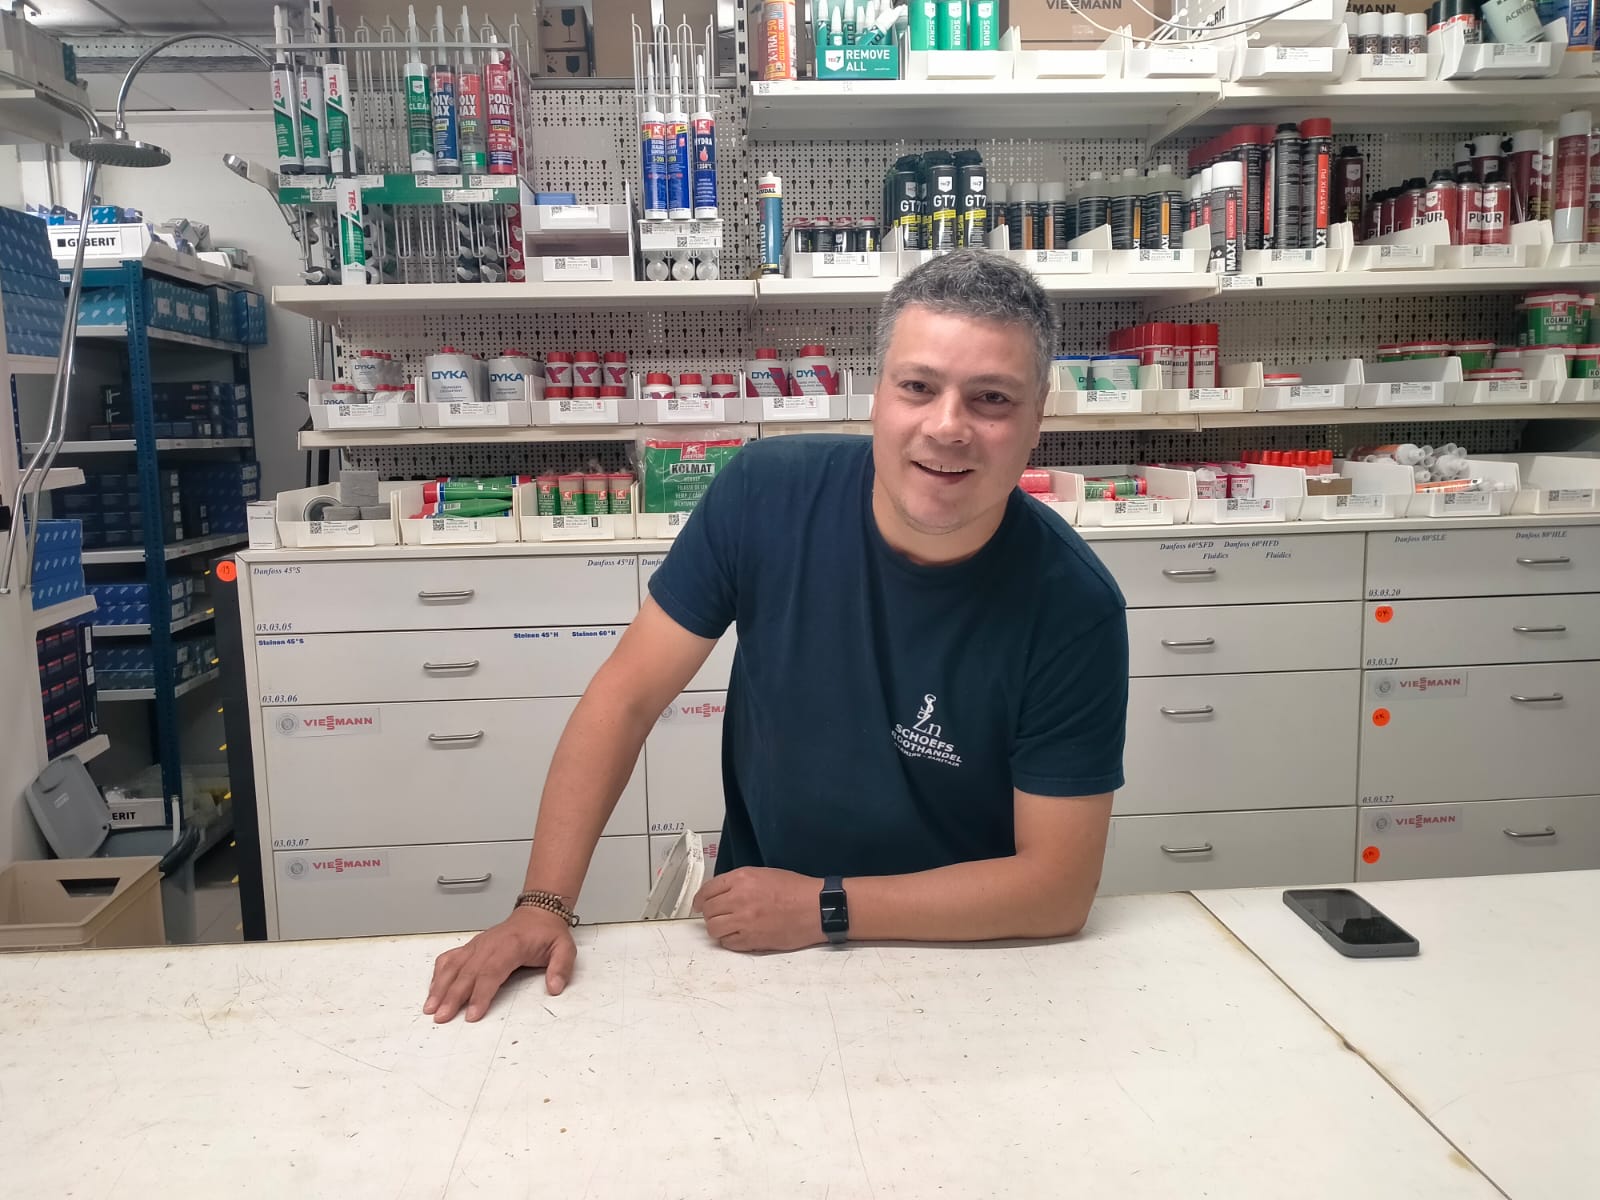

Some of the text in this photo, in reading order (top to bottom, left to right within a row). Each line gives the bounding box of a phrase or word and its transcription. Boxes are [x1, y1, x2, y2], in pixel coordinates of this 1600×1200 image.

[846, 50, 890, 60] REMOVE
[846, 62, 867, 71] ALL
[489, 104, 510, 114] MAX
[934, 194, 956, 207] GT7
[965, 194, 987, 207] GT7
[900, 200, 921, 212] GT7
[67, 237, 116, 247] GBERIT
[1226, 242, 1236, 271] MAX
[432, 371, 468, 379] DYKA
[490, 373, 524, 382] DYKA
[672, 464, 712, 474] KOLMAT
[257, 623, 292, 631] 03.03.05
[1367, 658, 1398, 666] 03.03.21
[1400, 677, 1461, 691] VIESSMANN
[262, 695, 297, 703] 03.03.06
[304, 716, 372, 730] VIESSMANN
[894, 724, 954, 752] SCHOEFS
[891, 730, 963, 763] ROOTHANDEL
[1362, 795, 1393, 803] 03.03.22
[112, 811, 136, 820] ERIT
[1395, 814, 1456, 828] VIESSMANN
[651, 823, 685, 831] 03.03.12
[274, 839, 309, 848] 03.03.07
[312, 858, 380, 872] VIESSMANN
